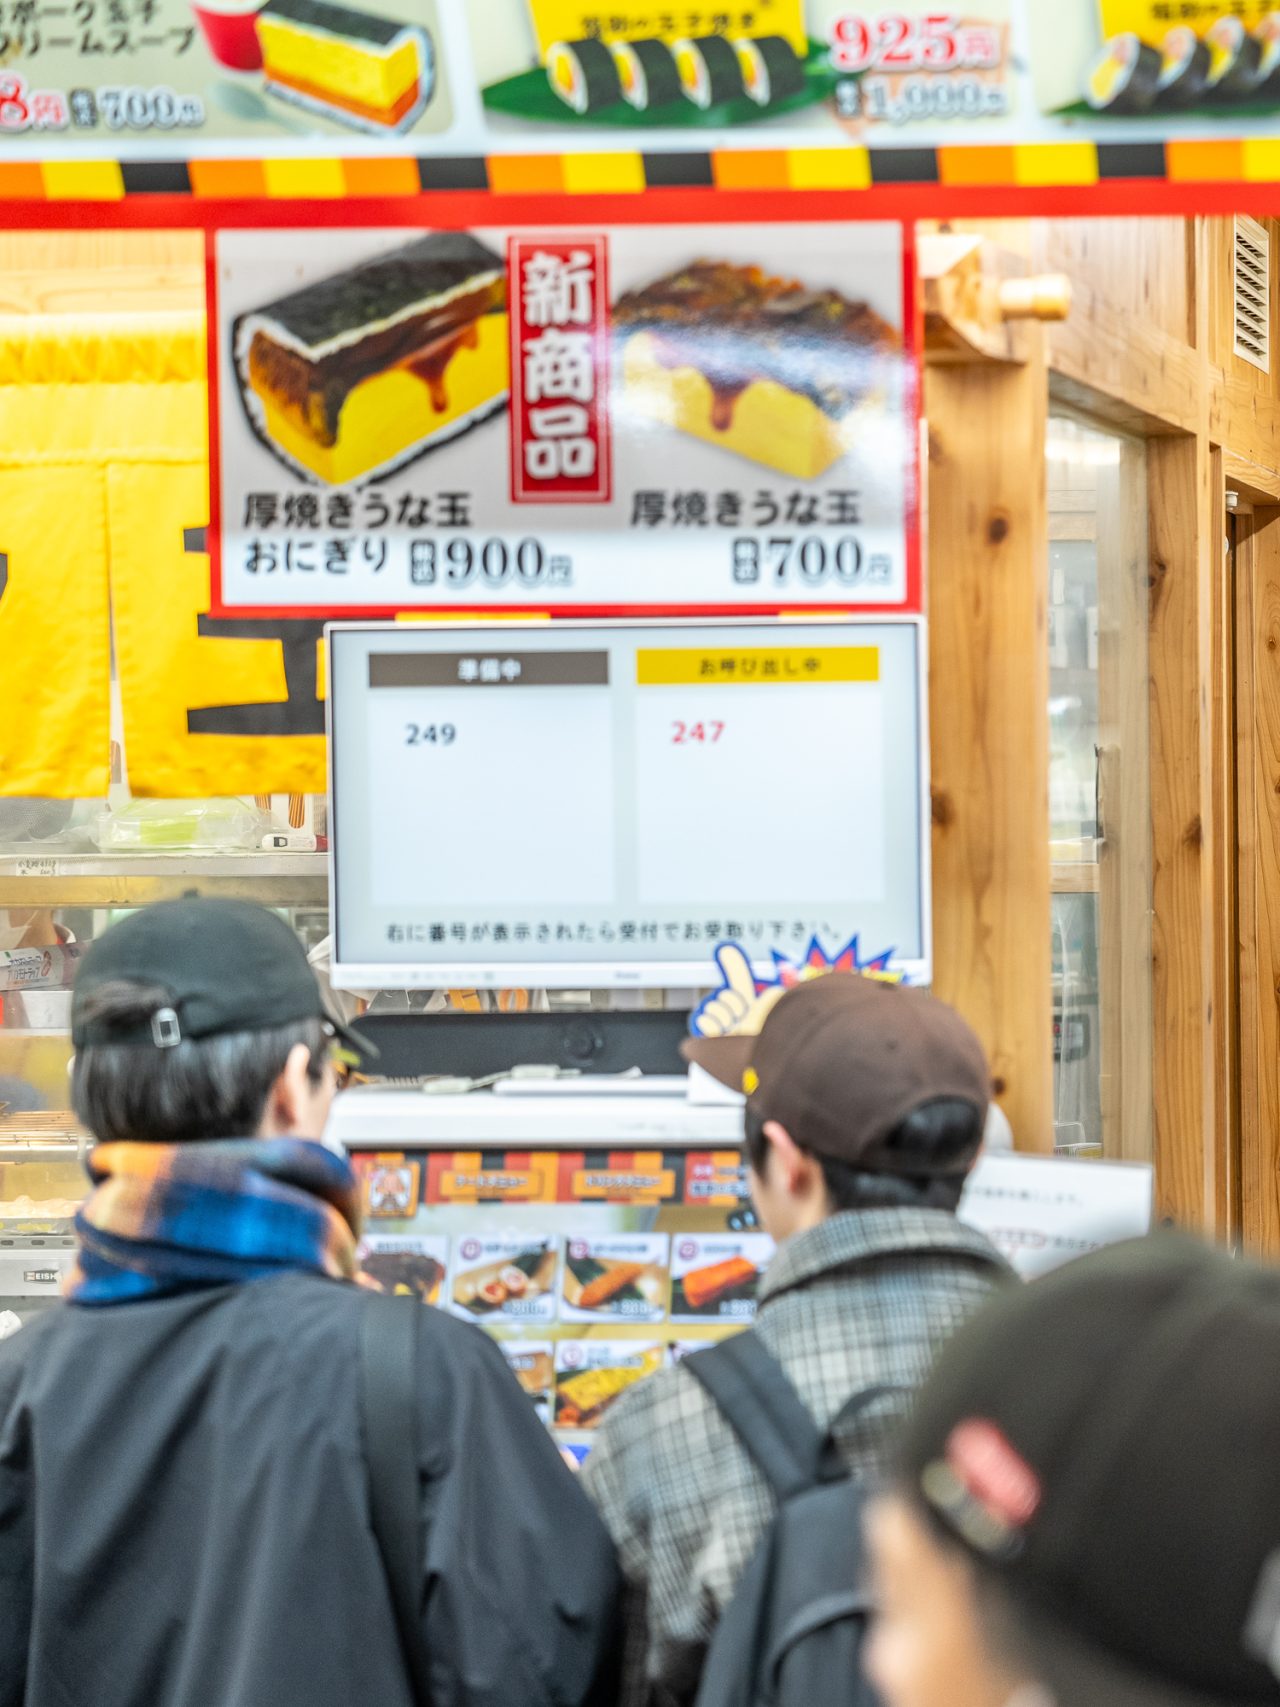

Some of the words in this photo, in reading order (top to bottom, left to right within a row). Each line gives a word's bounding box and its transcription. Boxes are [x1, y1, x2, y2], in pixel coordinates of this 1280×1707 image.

[524, 251, 595, 479] 新商品
[244, 492, 473, 529] 厚焼きうな玉
[630, 490, 863, 528] 厚焼きうな玉
[246, 536, 388, 574] おにぎり
[445, 537, 574, 588] 900円
[767, 536, 893, 587] 700円
[457, 658, 522, 682] 準備中
[698, 657, 822, 677] お呼び出し中
[405, 722, 457, 746] 249
[671, 719, 727, 744] 247
